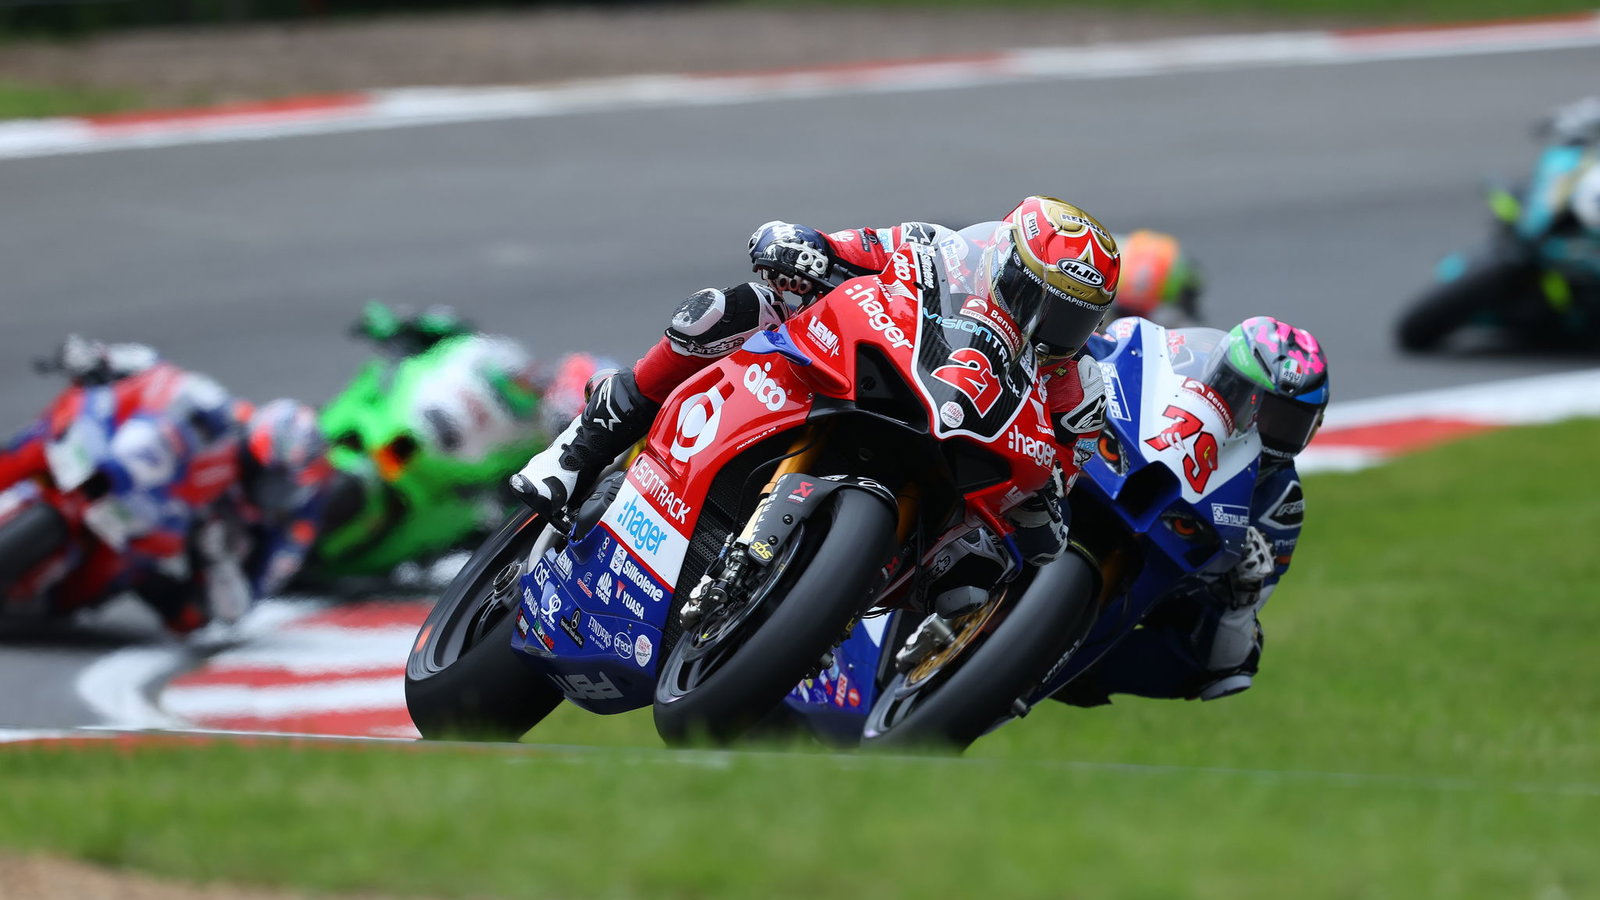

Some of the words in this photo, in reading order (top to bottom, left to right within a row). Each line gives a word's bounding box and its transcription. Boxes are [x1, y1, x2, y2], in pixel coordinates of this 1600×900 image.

[1064, 262, 1101, 284] HJC
[807, 315, 839, 350] LEW
[743, 361, 787, 412] aico
[930, 347, 1004, 419] 21
[1143, 404, 1219, 495] 79
[630, 459, 692, 525] VISIONTRACK
[622, 560, 664, 602] Silkolene
[621, 591, 645, 620] YUASA
